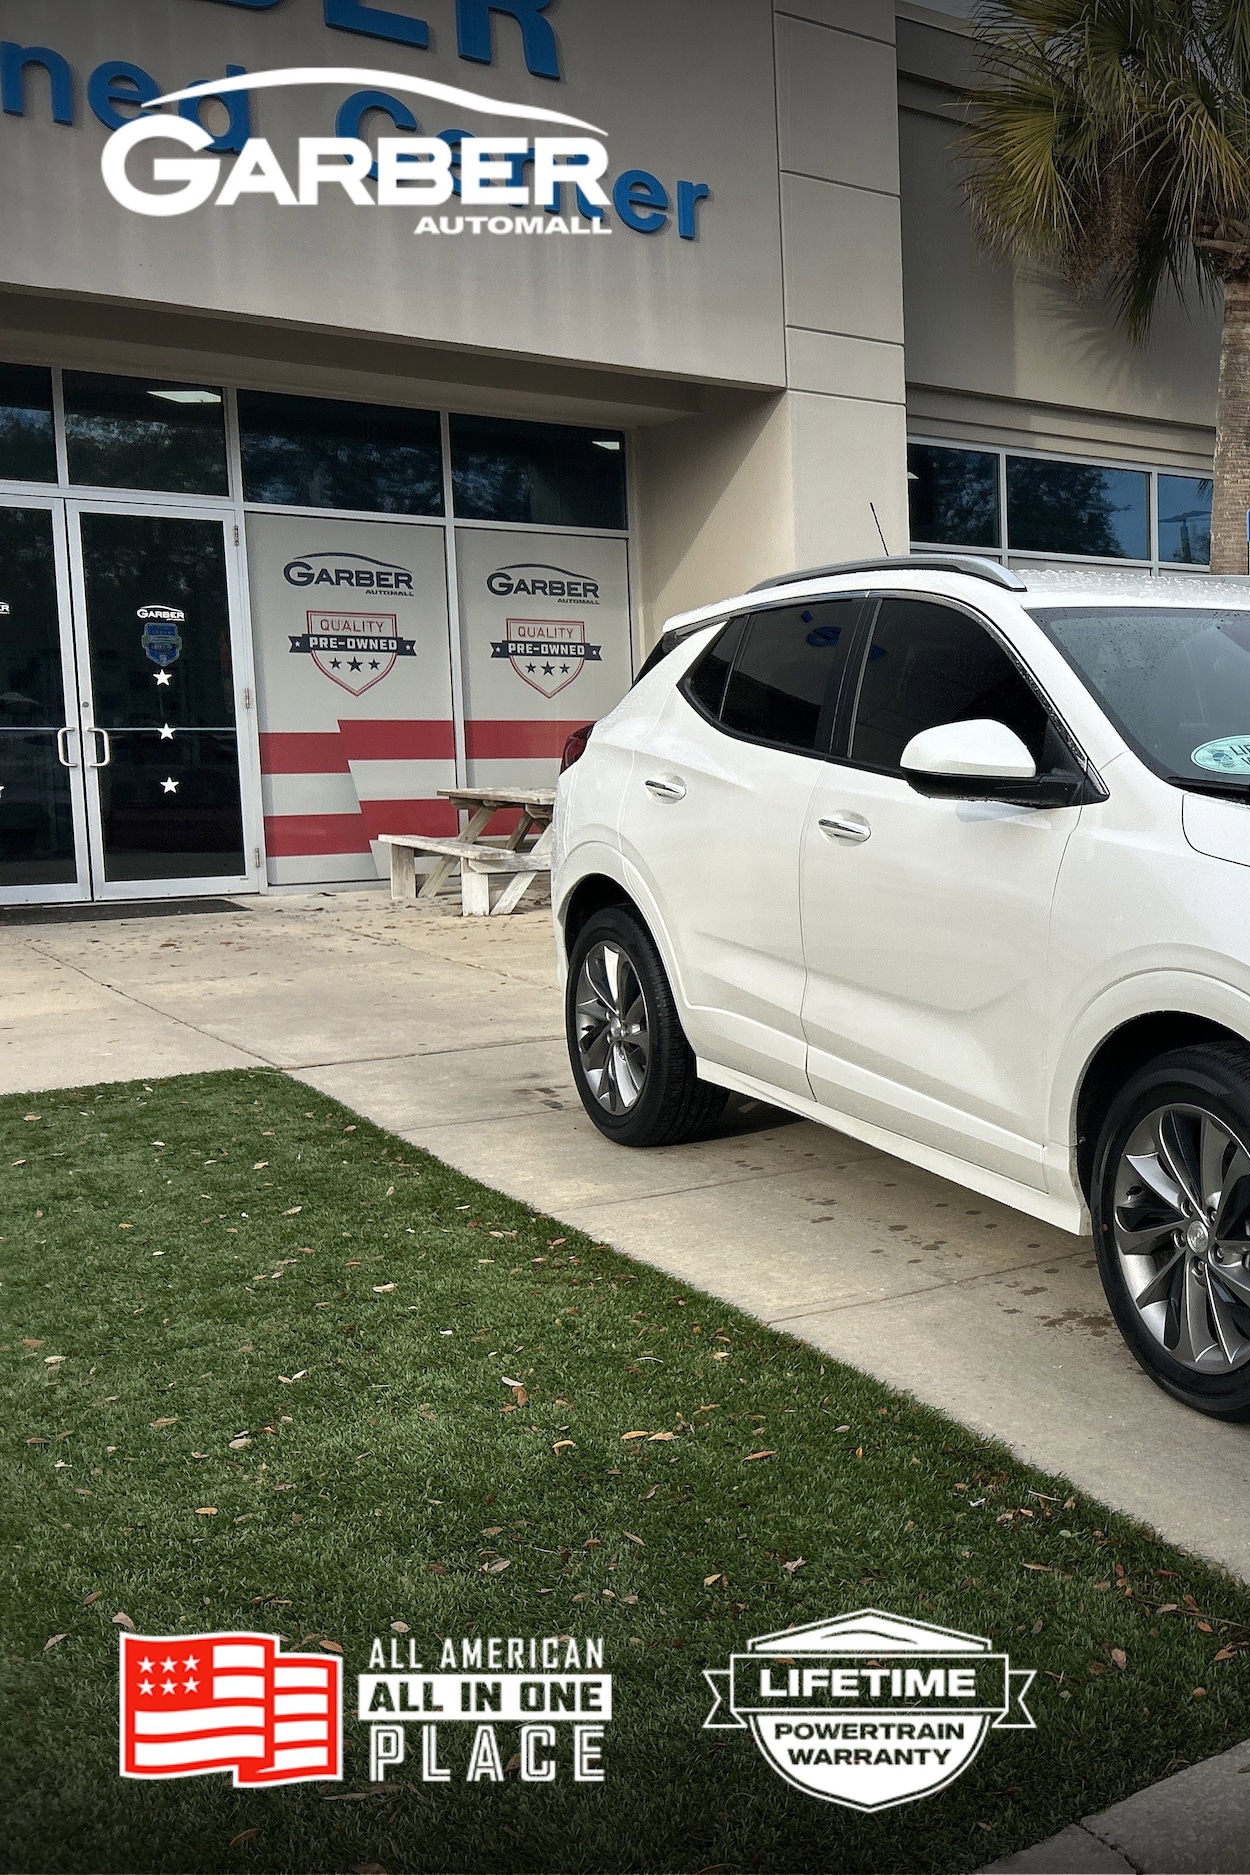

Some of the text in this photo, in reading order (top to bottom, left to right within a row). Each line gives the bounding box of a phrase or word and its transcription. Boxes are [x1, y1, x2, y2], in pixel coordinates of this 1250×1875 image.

[283, 561, 414, 590] GARBER
[486, 572, 600, 599] GARBER
[365, 589, 415, 597] AUTOMALL
[136, 608, 185, 619] GARBER
[320, 618, 384, 632] QUALITY
[518, 626, 574, 639] QUALITY
[309, 636, 398, 651] PRE-OWNED
[508, 643, 585, 655] PRE-OWNED
